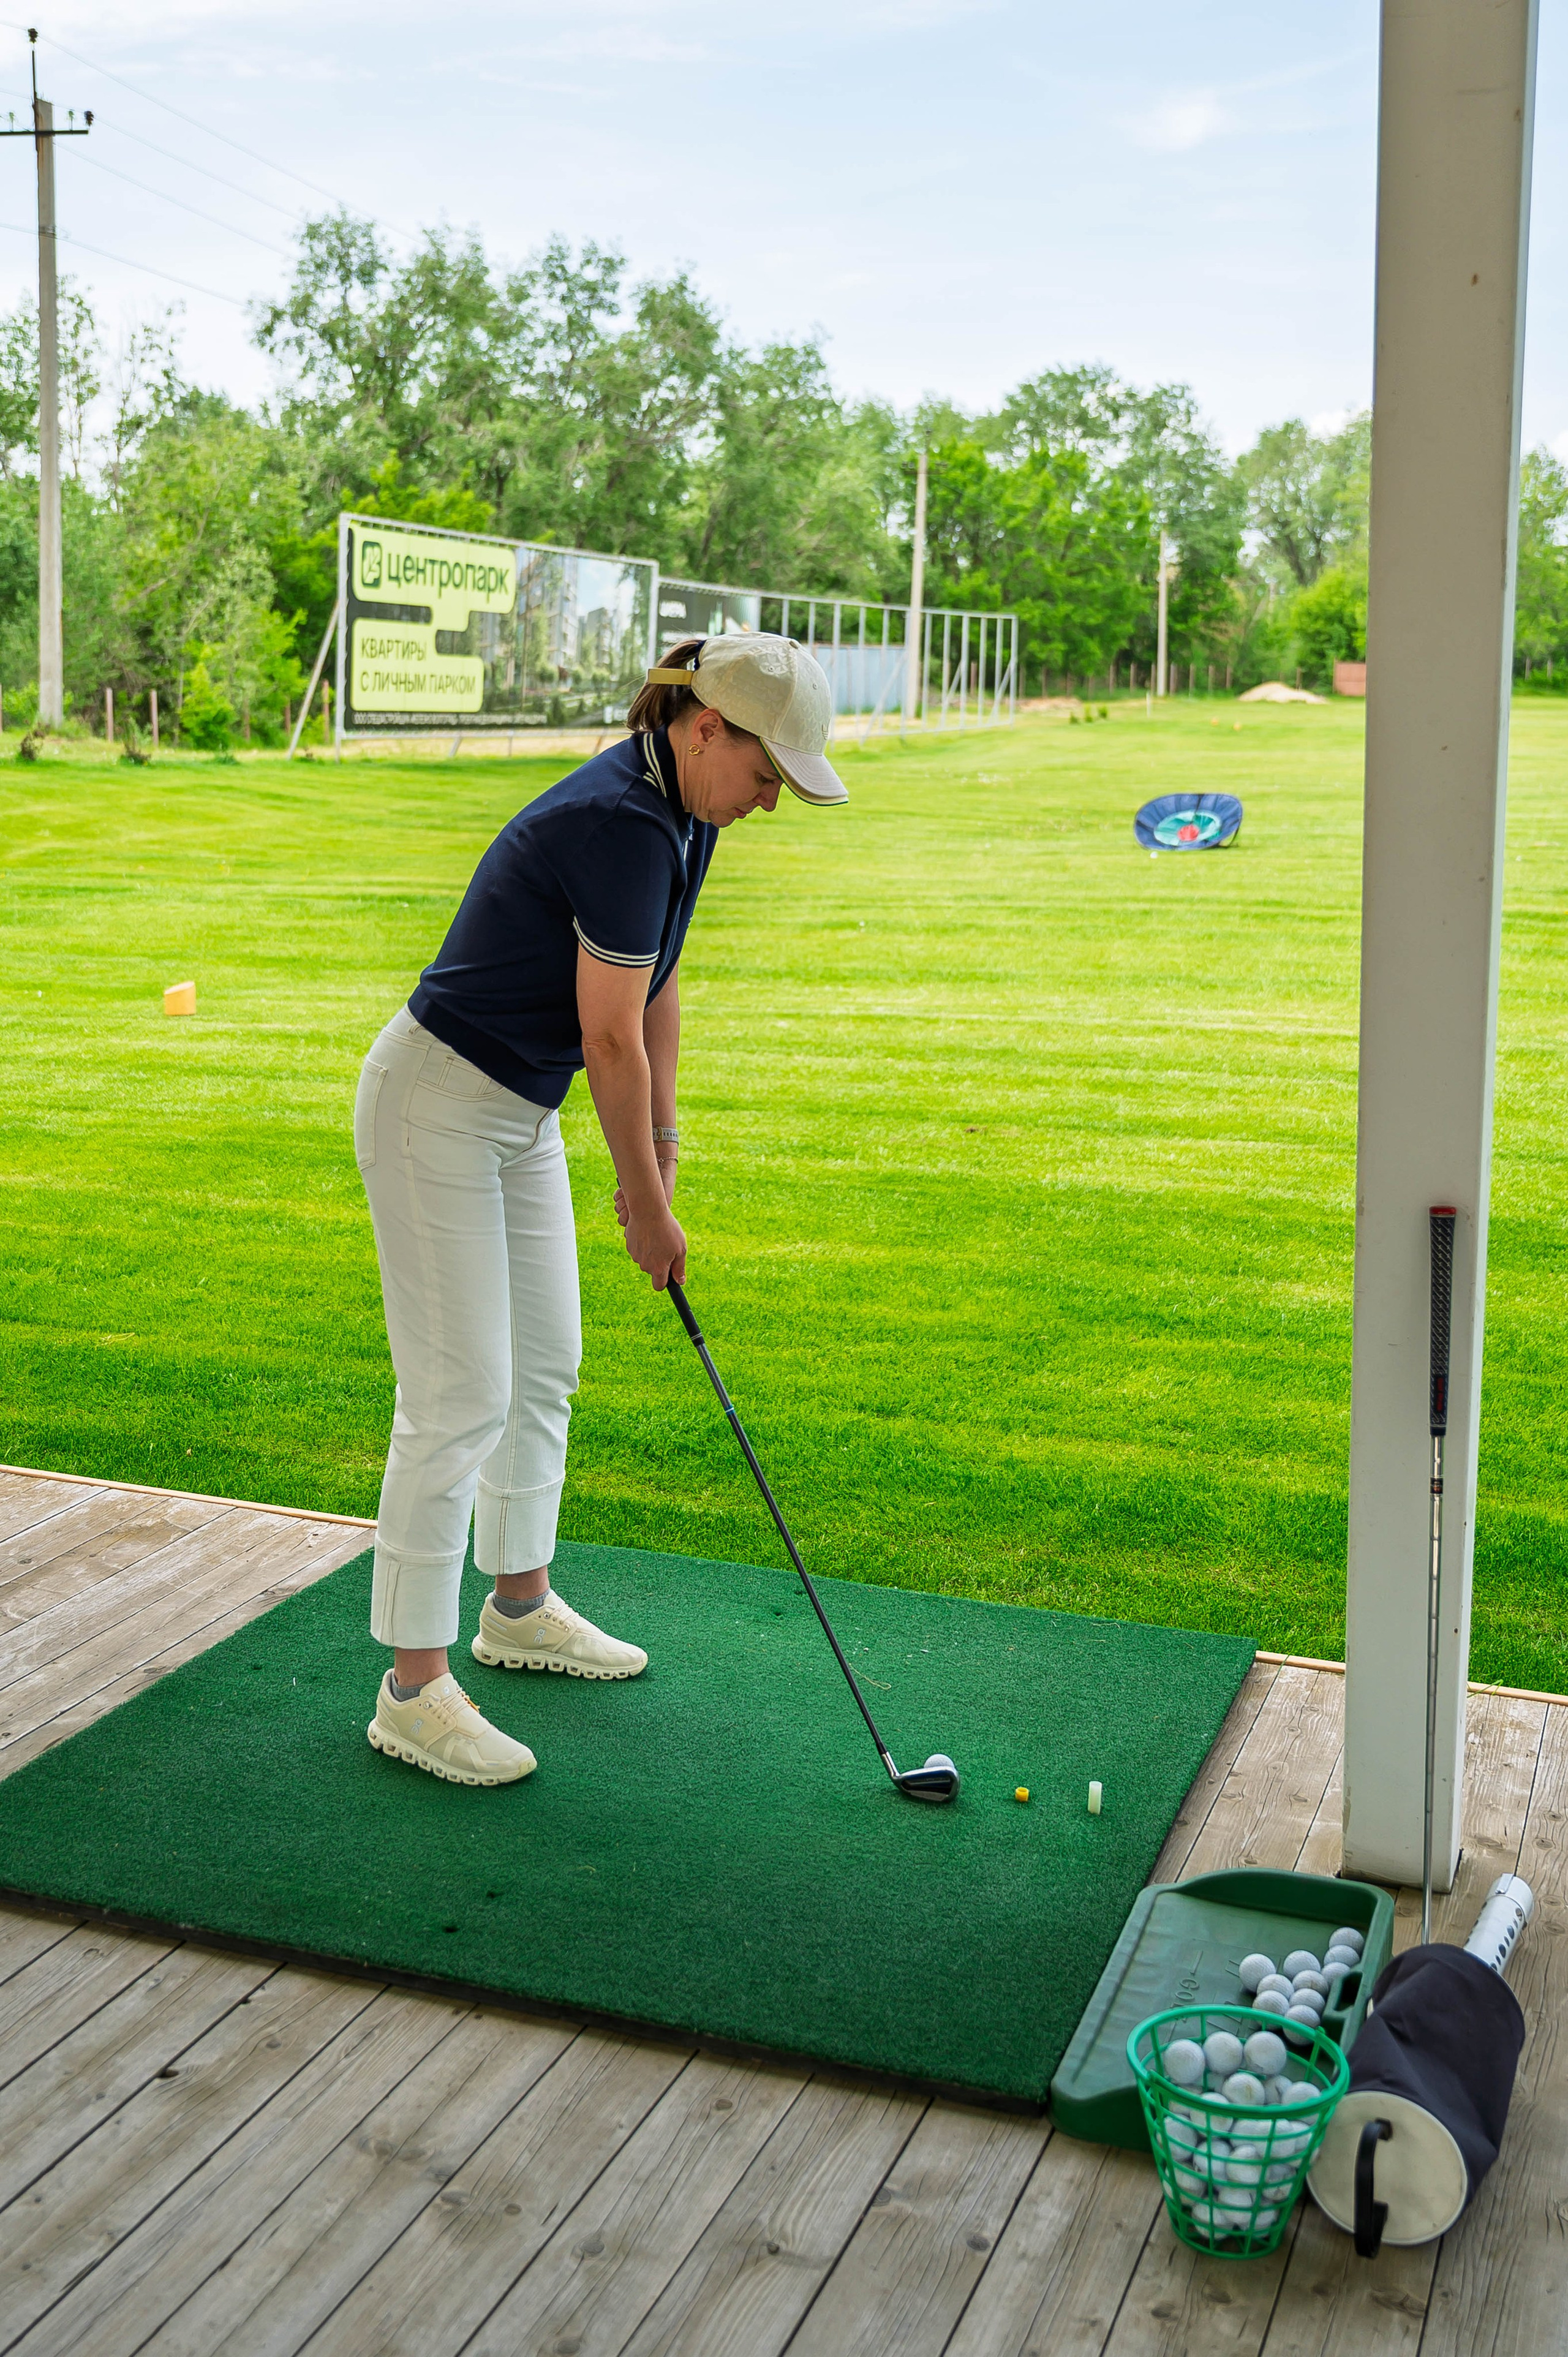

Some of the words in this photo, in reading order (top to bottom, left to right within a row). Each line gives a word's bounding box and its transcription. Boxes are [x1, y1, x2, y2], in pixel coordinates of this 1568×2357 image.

[388, 552, 510, 603] центропарк
[361, 638, 427, 662] КВАРТИРЫ
[361, 671, 369, 692] С
[372, 672, 426, 694] ЛИЧНЫМ
[429, 674, 475, 695] ПАРКОМ
